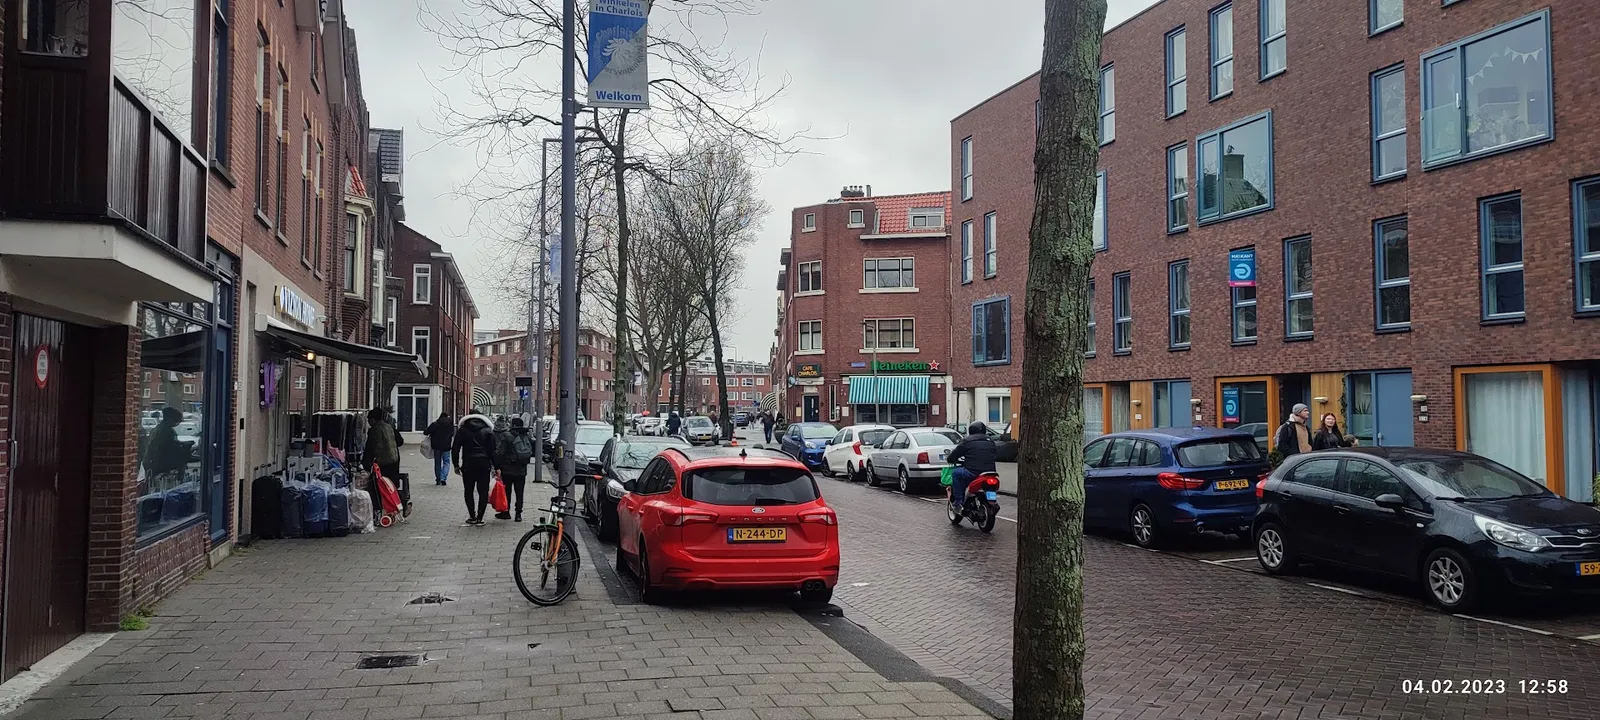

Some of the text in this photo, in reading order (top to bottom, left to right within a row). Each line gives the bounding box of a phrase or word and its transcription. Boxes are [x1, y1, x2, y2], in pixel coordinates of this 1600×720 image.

[595, 4, 643, 17] in Charlois
[596, 90, 642, 101] Welkom
[735, 529, 783, 539] N-244-DP
